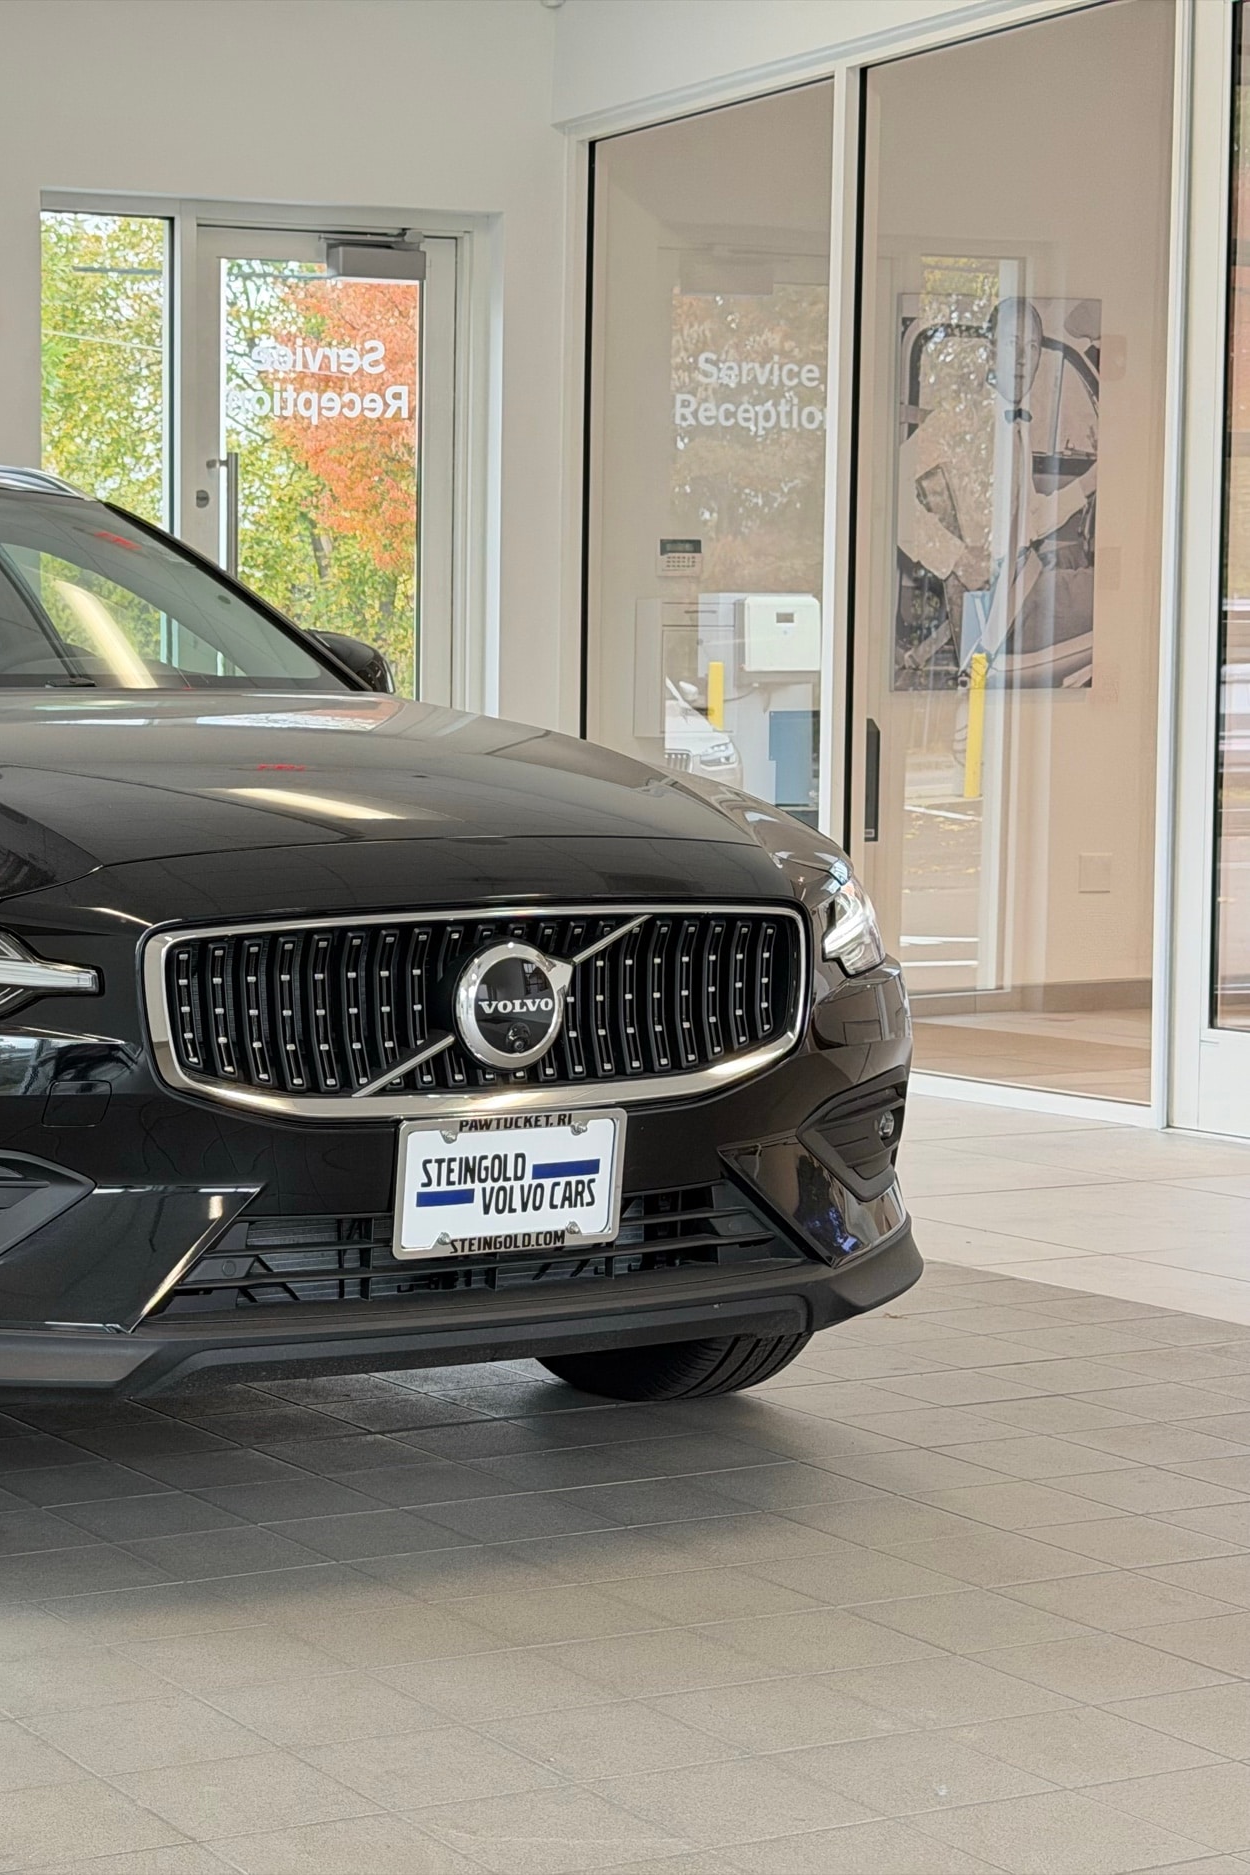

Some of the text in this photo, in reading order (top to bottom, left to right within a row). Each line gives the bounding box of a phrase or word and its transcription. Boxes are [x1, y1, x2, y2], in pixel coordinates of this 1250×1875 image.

[698, 352, 821, 388] Service
[674, 393, 828, 435] Receptio
[478, 998, 554, 1014] VOLVO
[557, 1113, 573, 1127] RI
[420, 1152, 527, 1188] STEINGOLD
[481, 1178, 596, 1215] VOLVO CARS
[449, 1230, 566, 1255] STEINGOLD.COM
